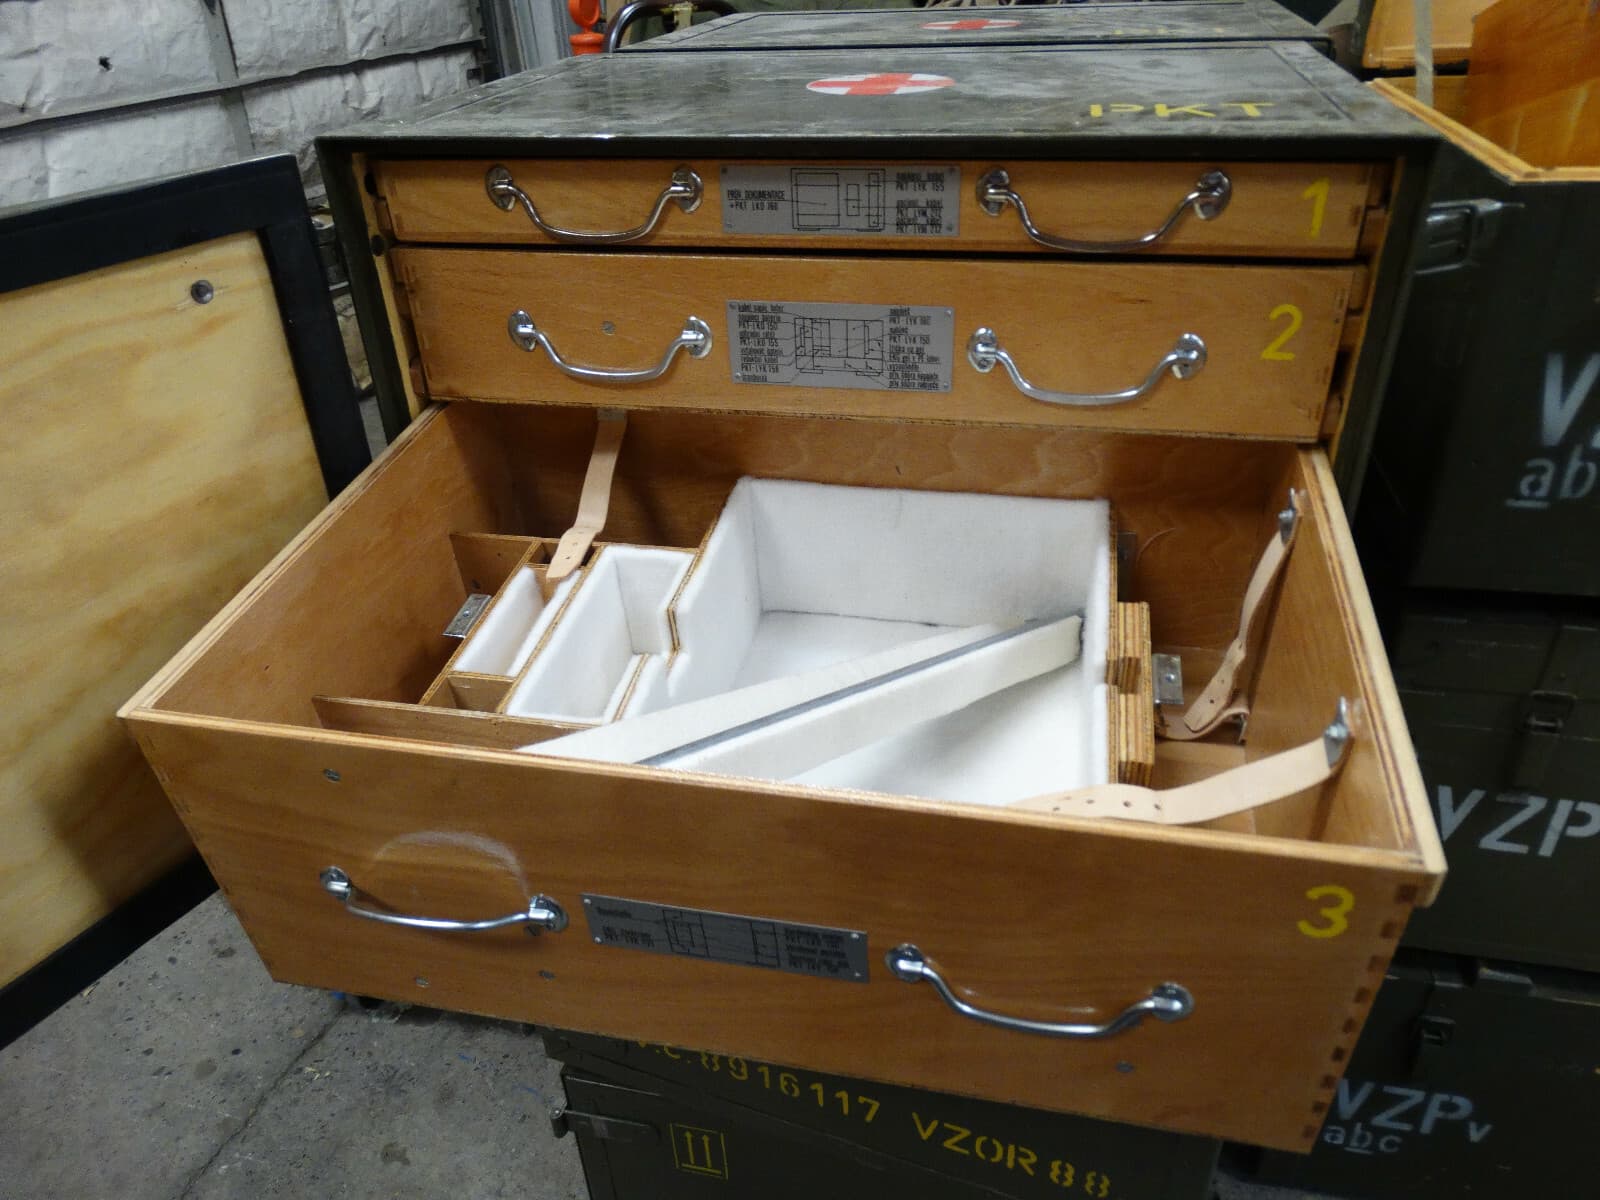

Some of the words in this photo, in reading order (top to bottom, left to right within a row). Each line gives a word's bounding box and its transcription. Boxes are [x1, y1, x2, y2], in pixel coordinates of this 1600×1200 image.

[1089, 102, 1276, 118] PKT
[1303, 177, 1331, 239] 1
[1260, 303, 1303, 361] 2
[1541, 352, 1600, 449] V
[1296, 884, 1355, 939] 3
[911, 1112, 1038, 1176] VZOR
[1322, 1122, 1403, 1154] abc
